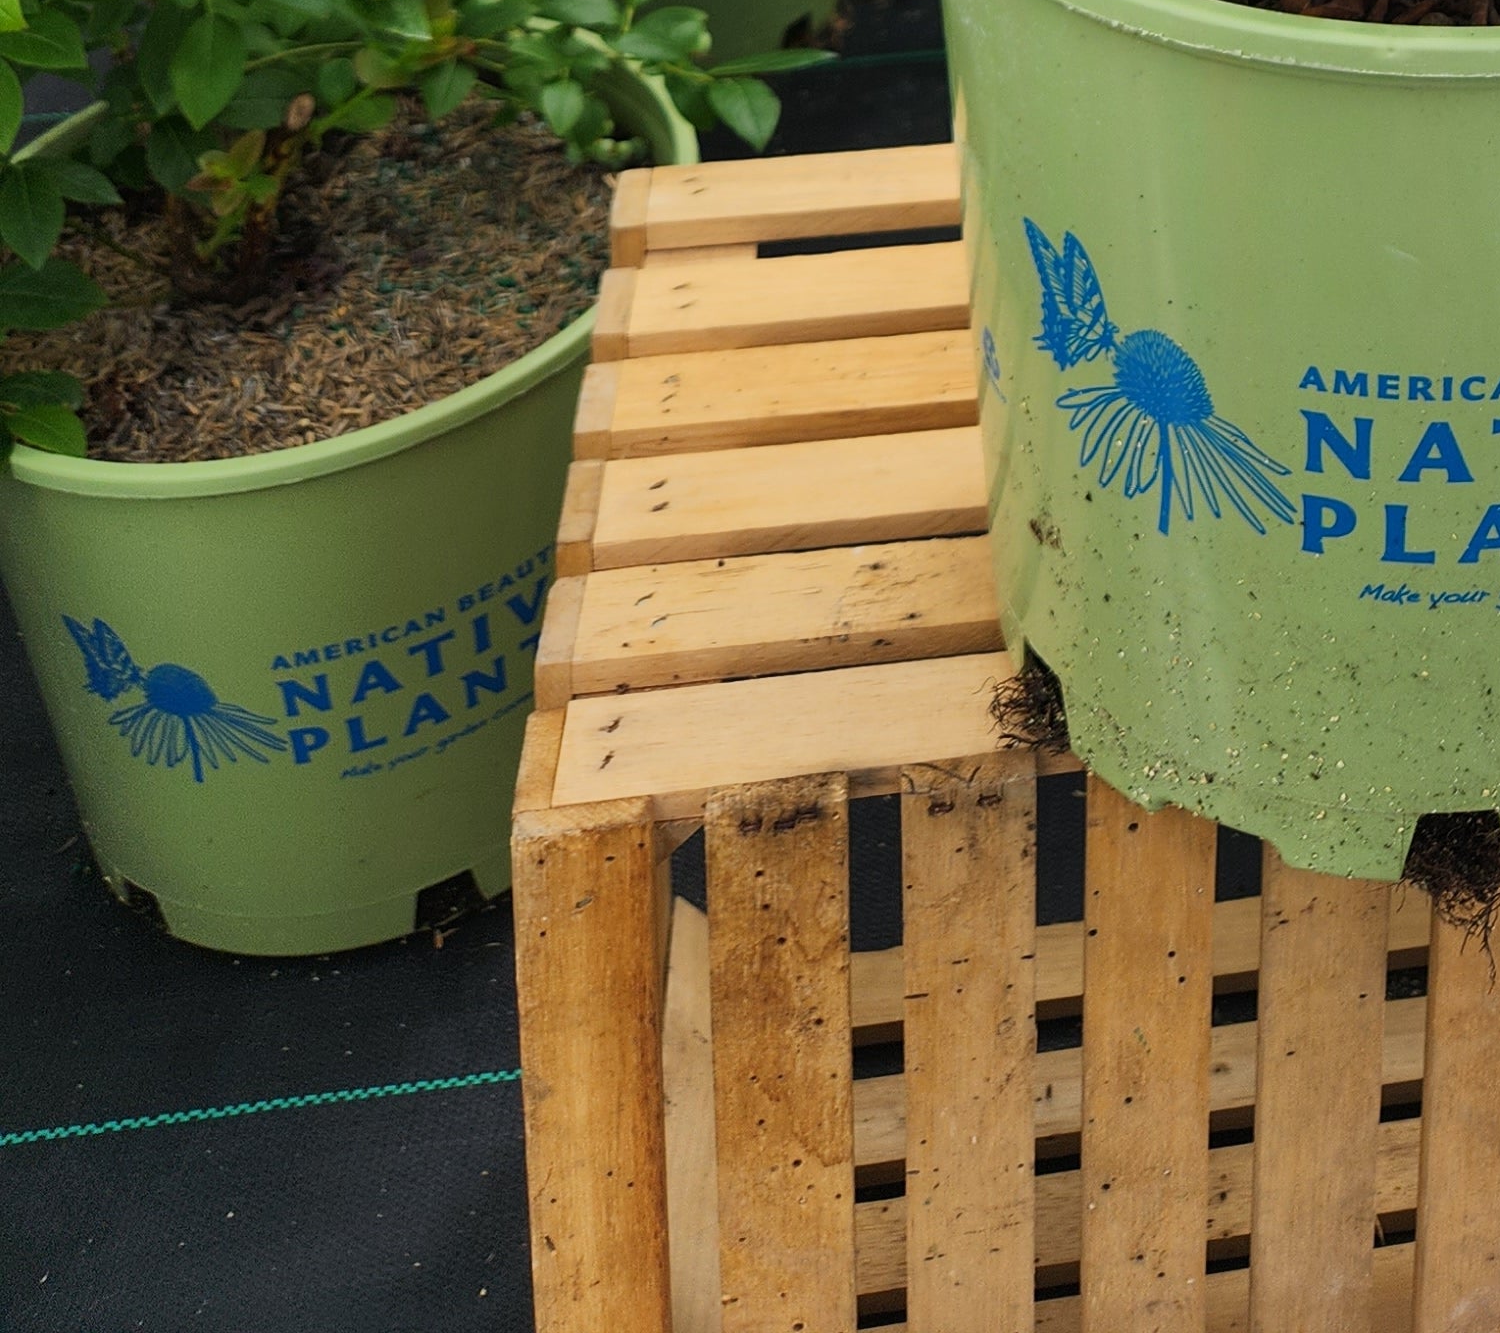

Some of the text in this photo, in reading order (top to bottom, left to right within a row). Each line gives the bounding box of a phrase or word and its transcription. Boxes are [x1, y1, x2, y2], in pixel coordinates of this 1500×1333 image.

[270, 544, 553, 671] AMERICAN BEAUT
[275, 574, 550, 718] NATIV
[1358, 583, 1421, 607] Make
[1429, 589, 1491, 610] your
